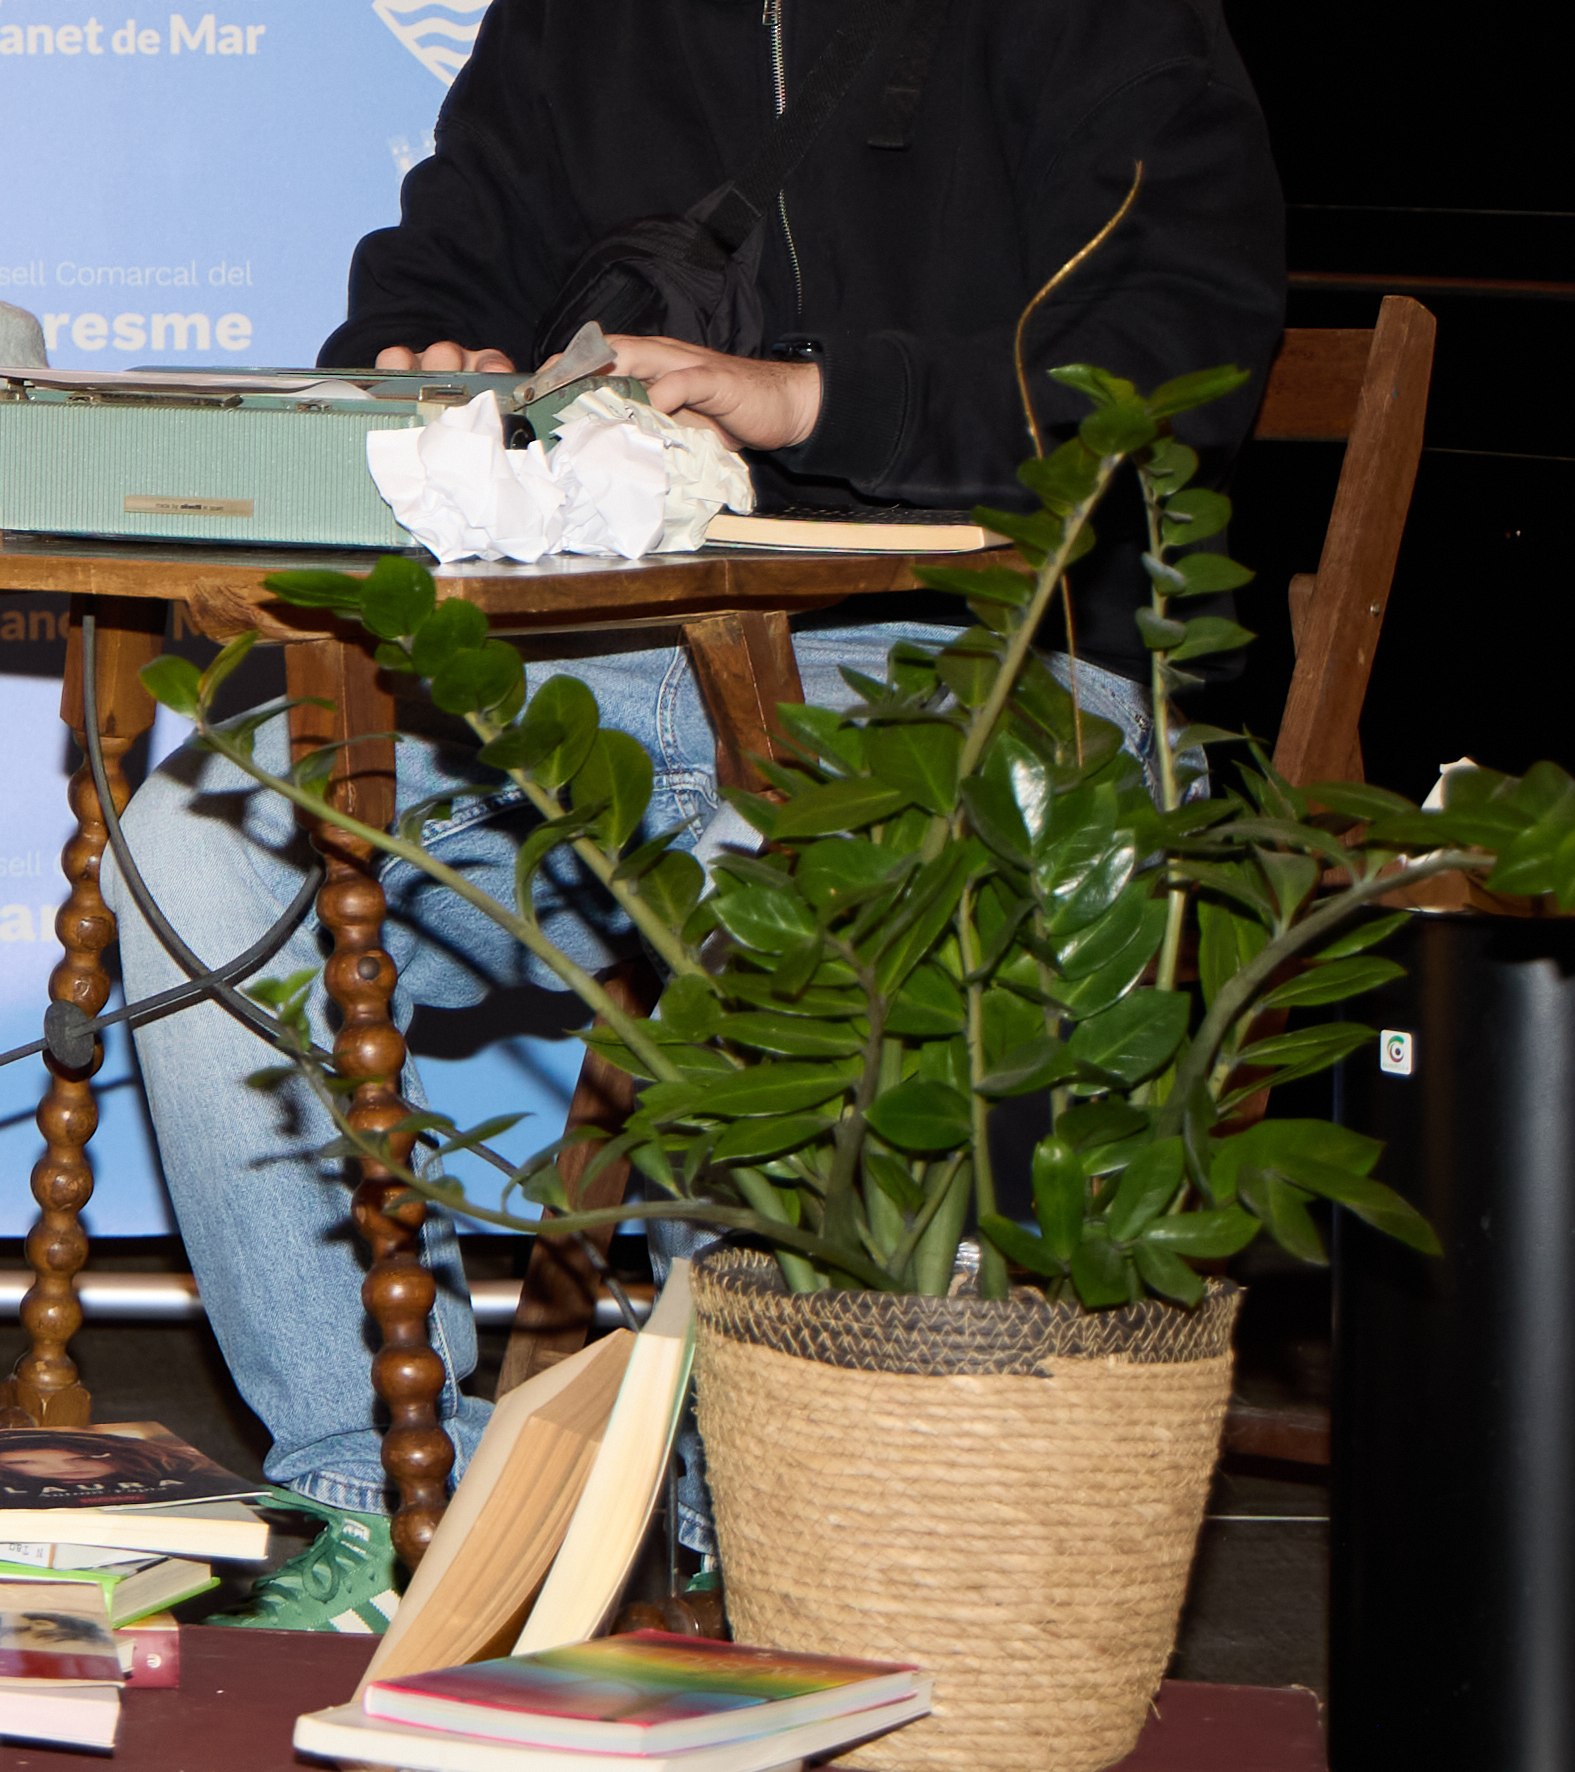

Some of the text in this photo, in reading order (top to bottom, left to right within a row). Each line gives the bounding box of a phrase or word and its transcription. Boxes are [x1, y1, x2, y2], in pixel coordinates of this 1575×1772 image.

[112, 20, 160, 54] de
[171, 15, 266, 54] Mar
[56, 260, 198, 286] Comarcal
[208, 261, 252, 286] del
[42, 312, 252, 351] resme
[4, 1477, 185, 1497] LAURA
